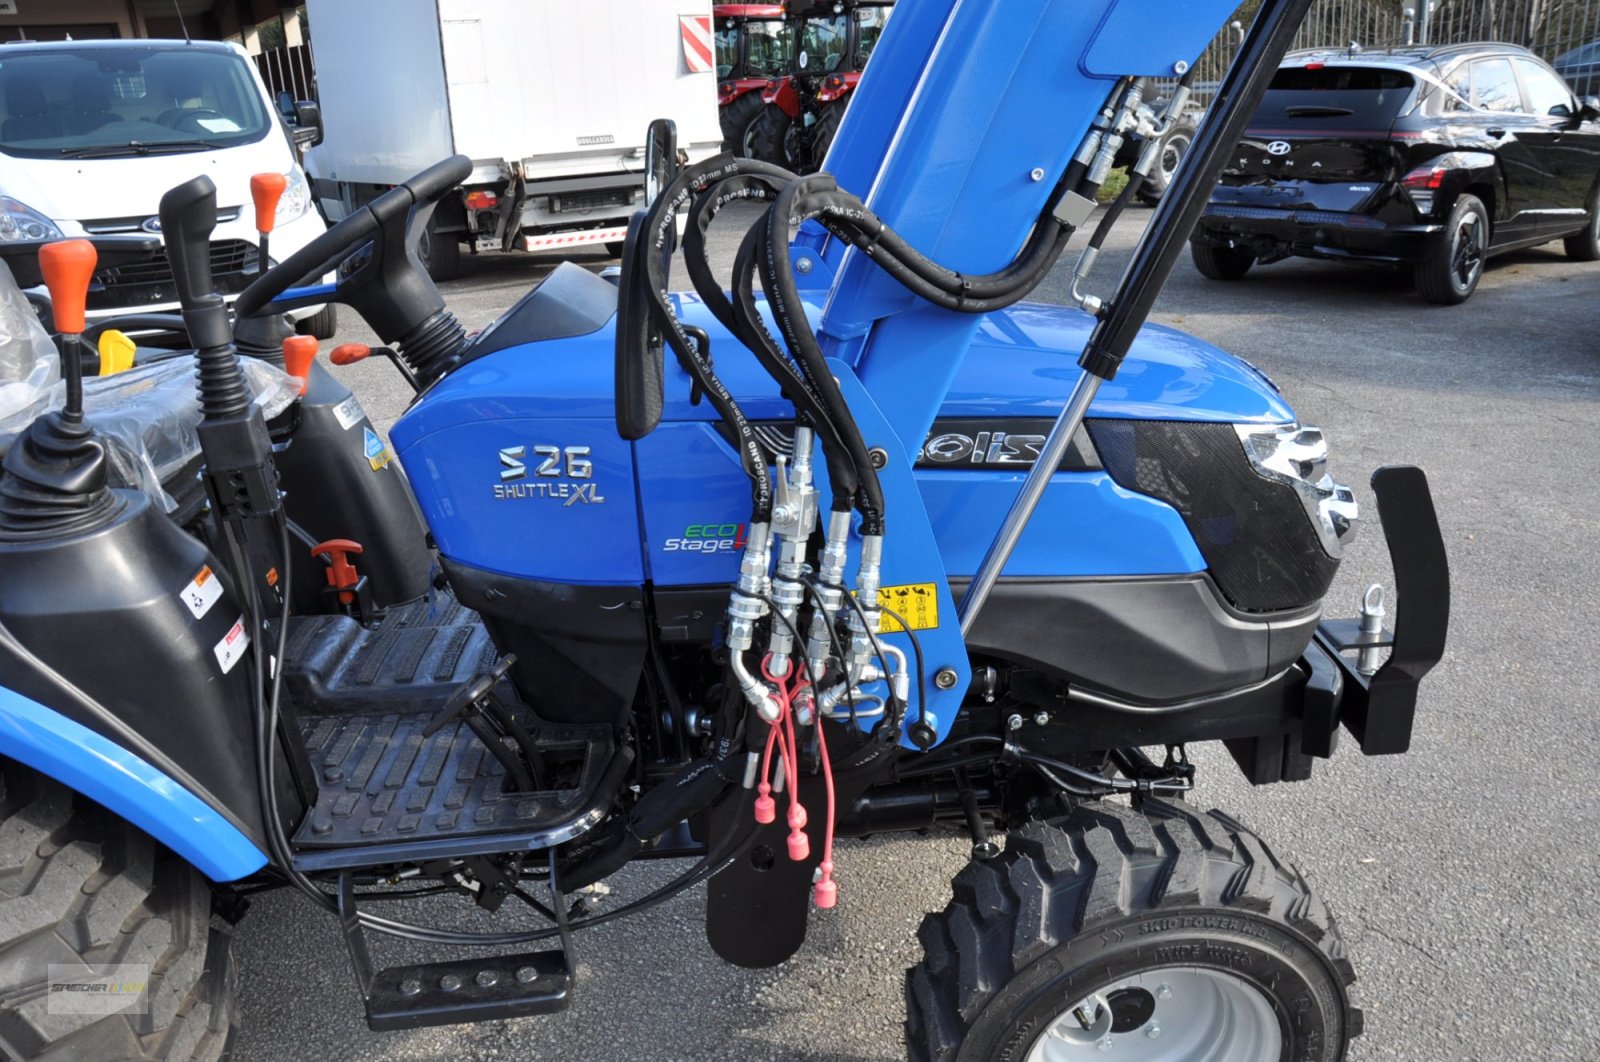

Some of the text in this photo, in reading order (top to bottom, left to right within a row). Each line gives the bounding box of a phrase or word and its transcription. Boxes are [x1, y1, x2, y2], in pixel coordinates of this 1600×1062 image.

[1240, 158, 1322, 167] KONA
[916, 431, 1046, 463] olis
[684, 523, 736, 538] ECO
[663, 538, 734, 554] Stage
